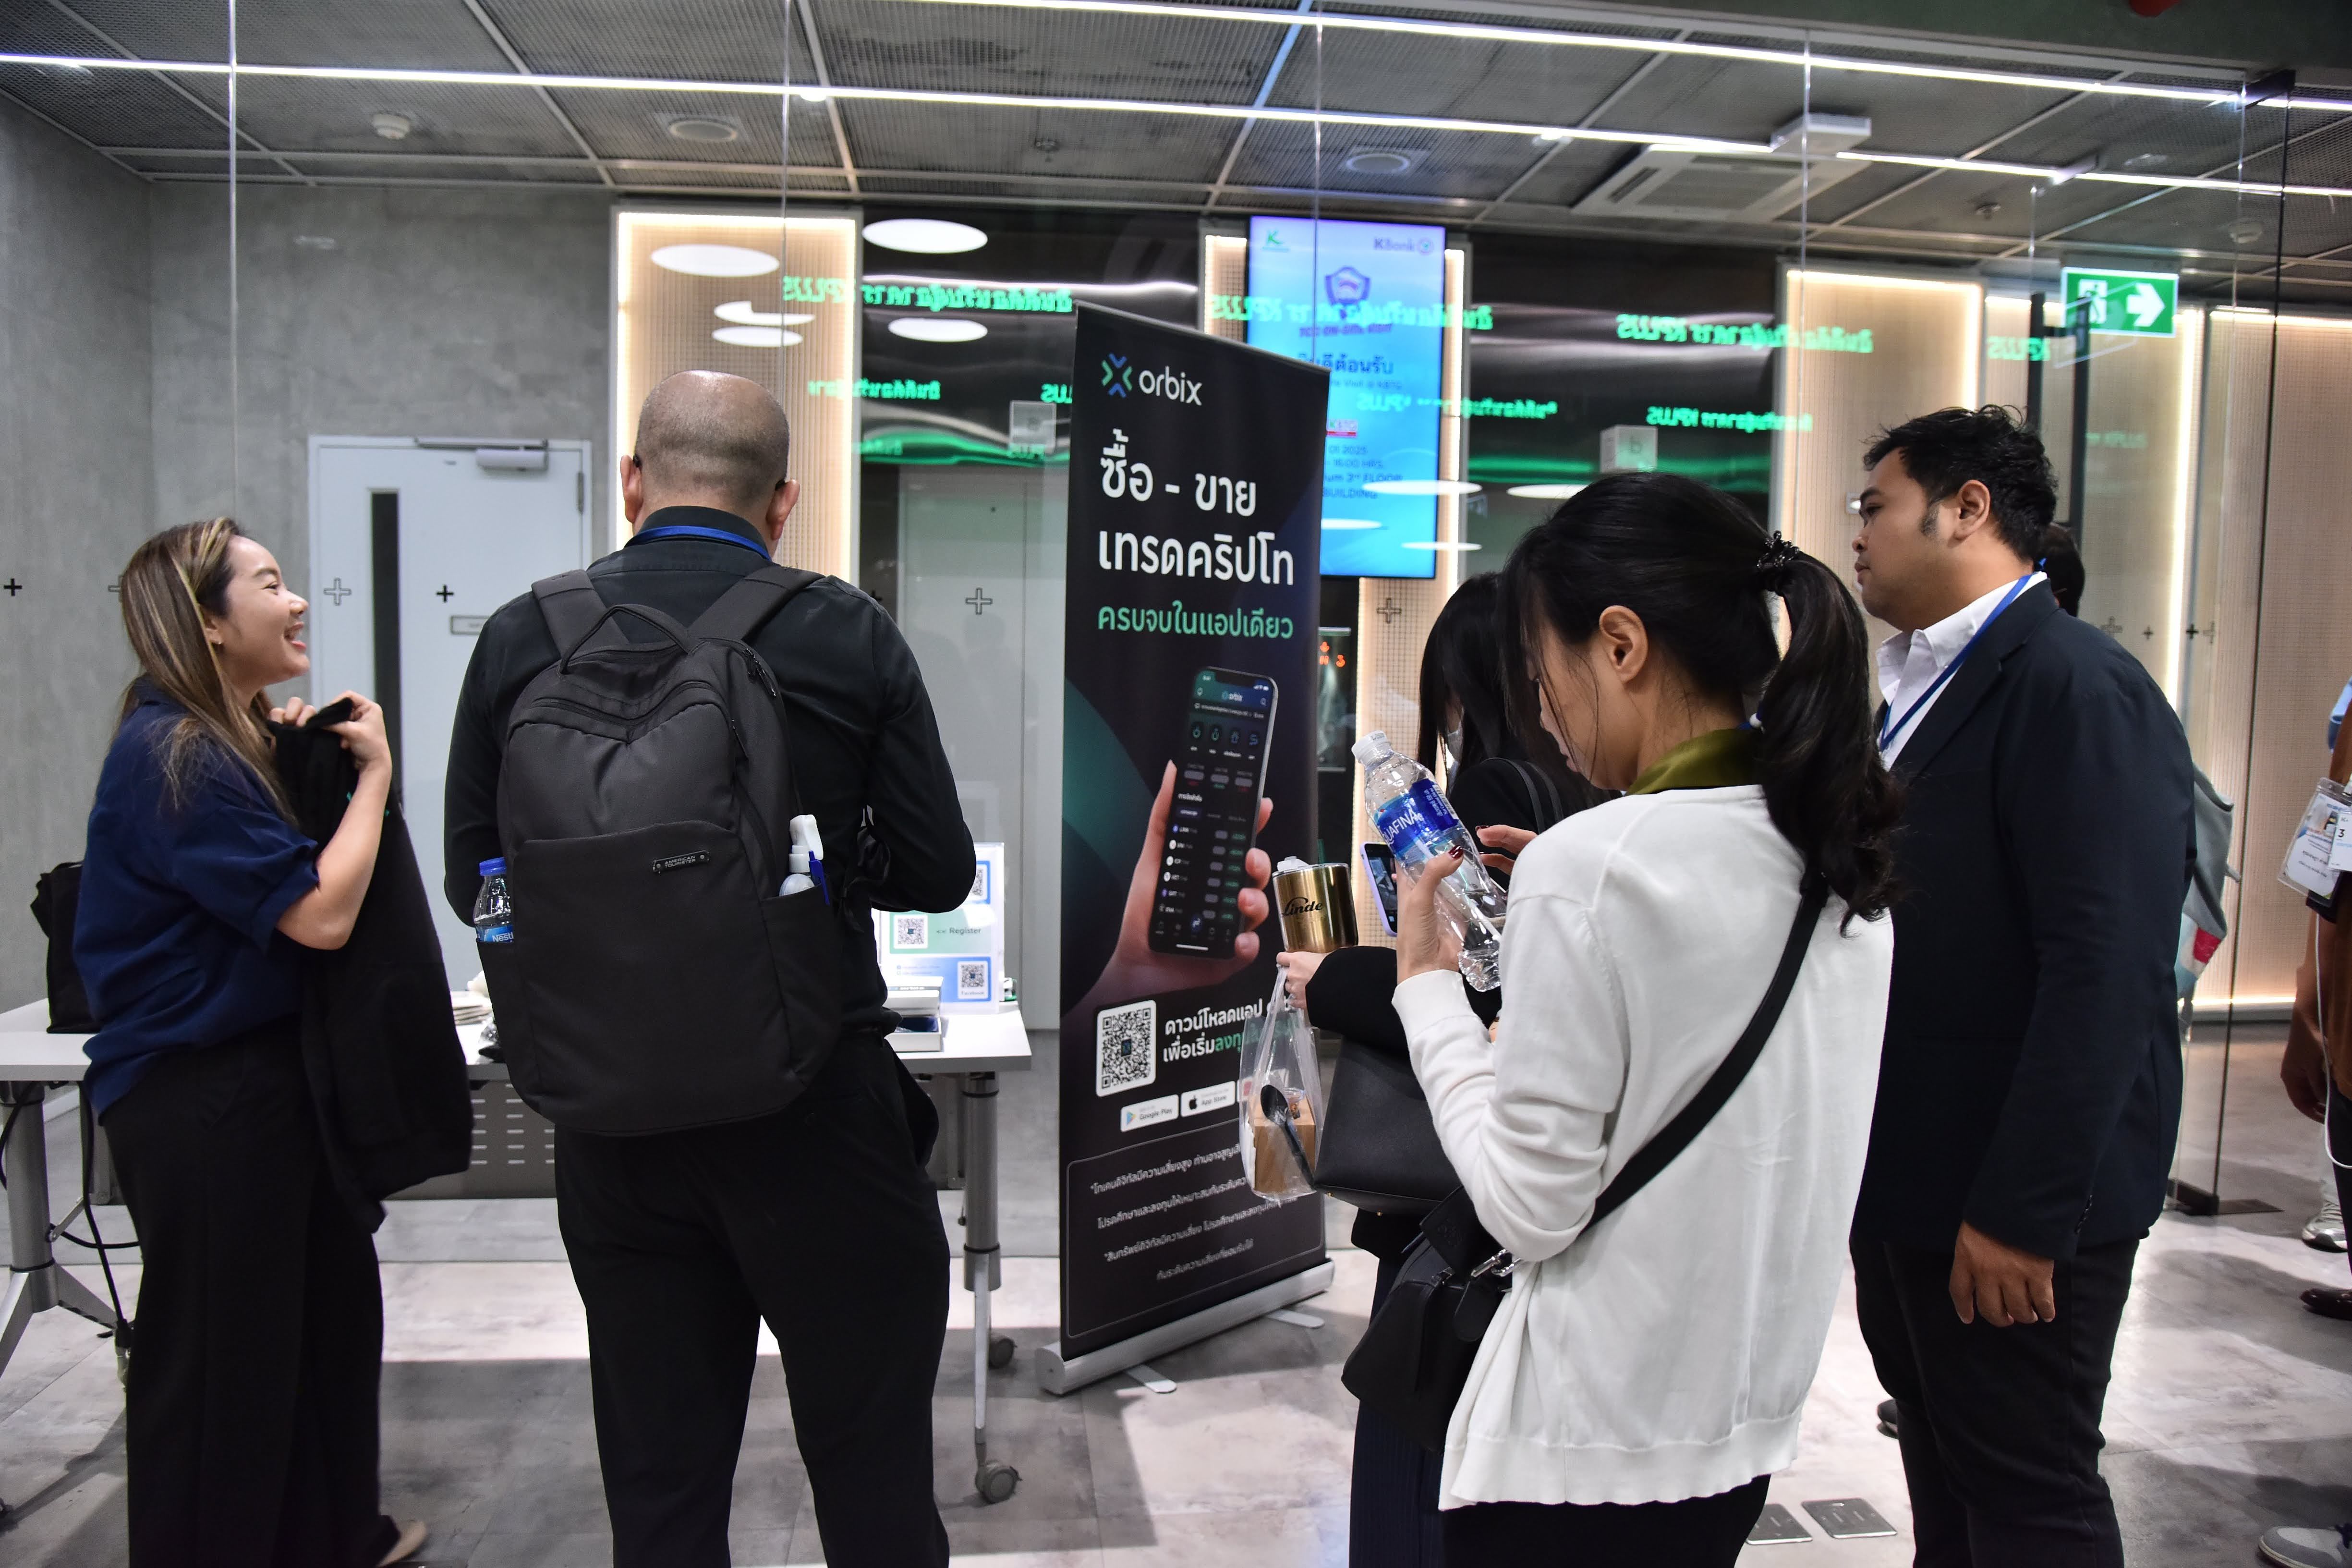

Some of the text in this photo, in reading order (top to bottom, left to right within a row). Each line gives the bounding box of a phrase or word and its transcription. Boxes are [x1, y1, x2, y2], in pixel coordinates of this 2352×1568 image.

[1138, 365, 1202, 406] orbix
[1100, 428, 1257, 517] ซื้อ - ขาย
[1099, 531, 1294, 585] เทรดคริปโท
[1098, 600, 1294, 639] ครบจบในแอปเดียว
[2338, 828, 2345, 838] 3
[664, 855, 696, 864] AMERICAN
[664, 859, 696, 868] TOURISTER
[1281, 896, 1323, 917] Linde
[492, 931, 515, 942] Nestl
[949, 927, 982, 936] Register
[1165, 998, 1263, 1036] ดาวน์โหลดแอป
